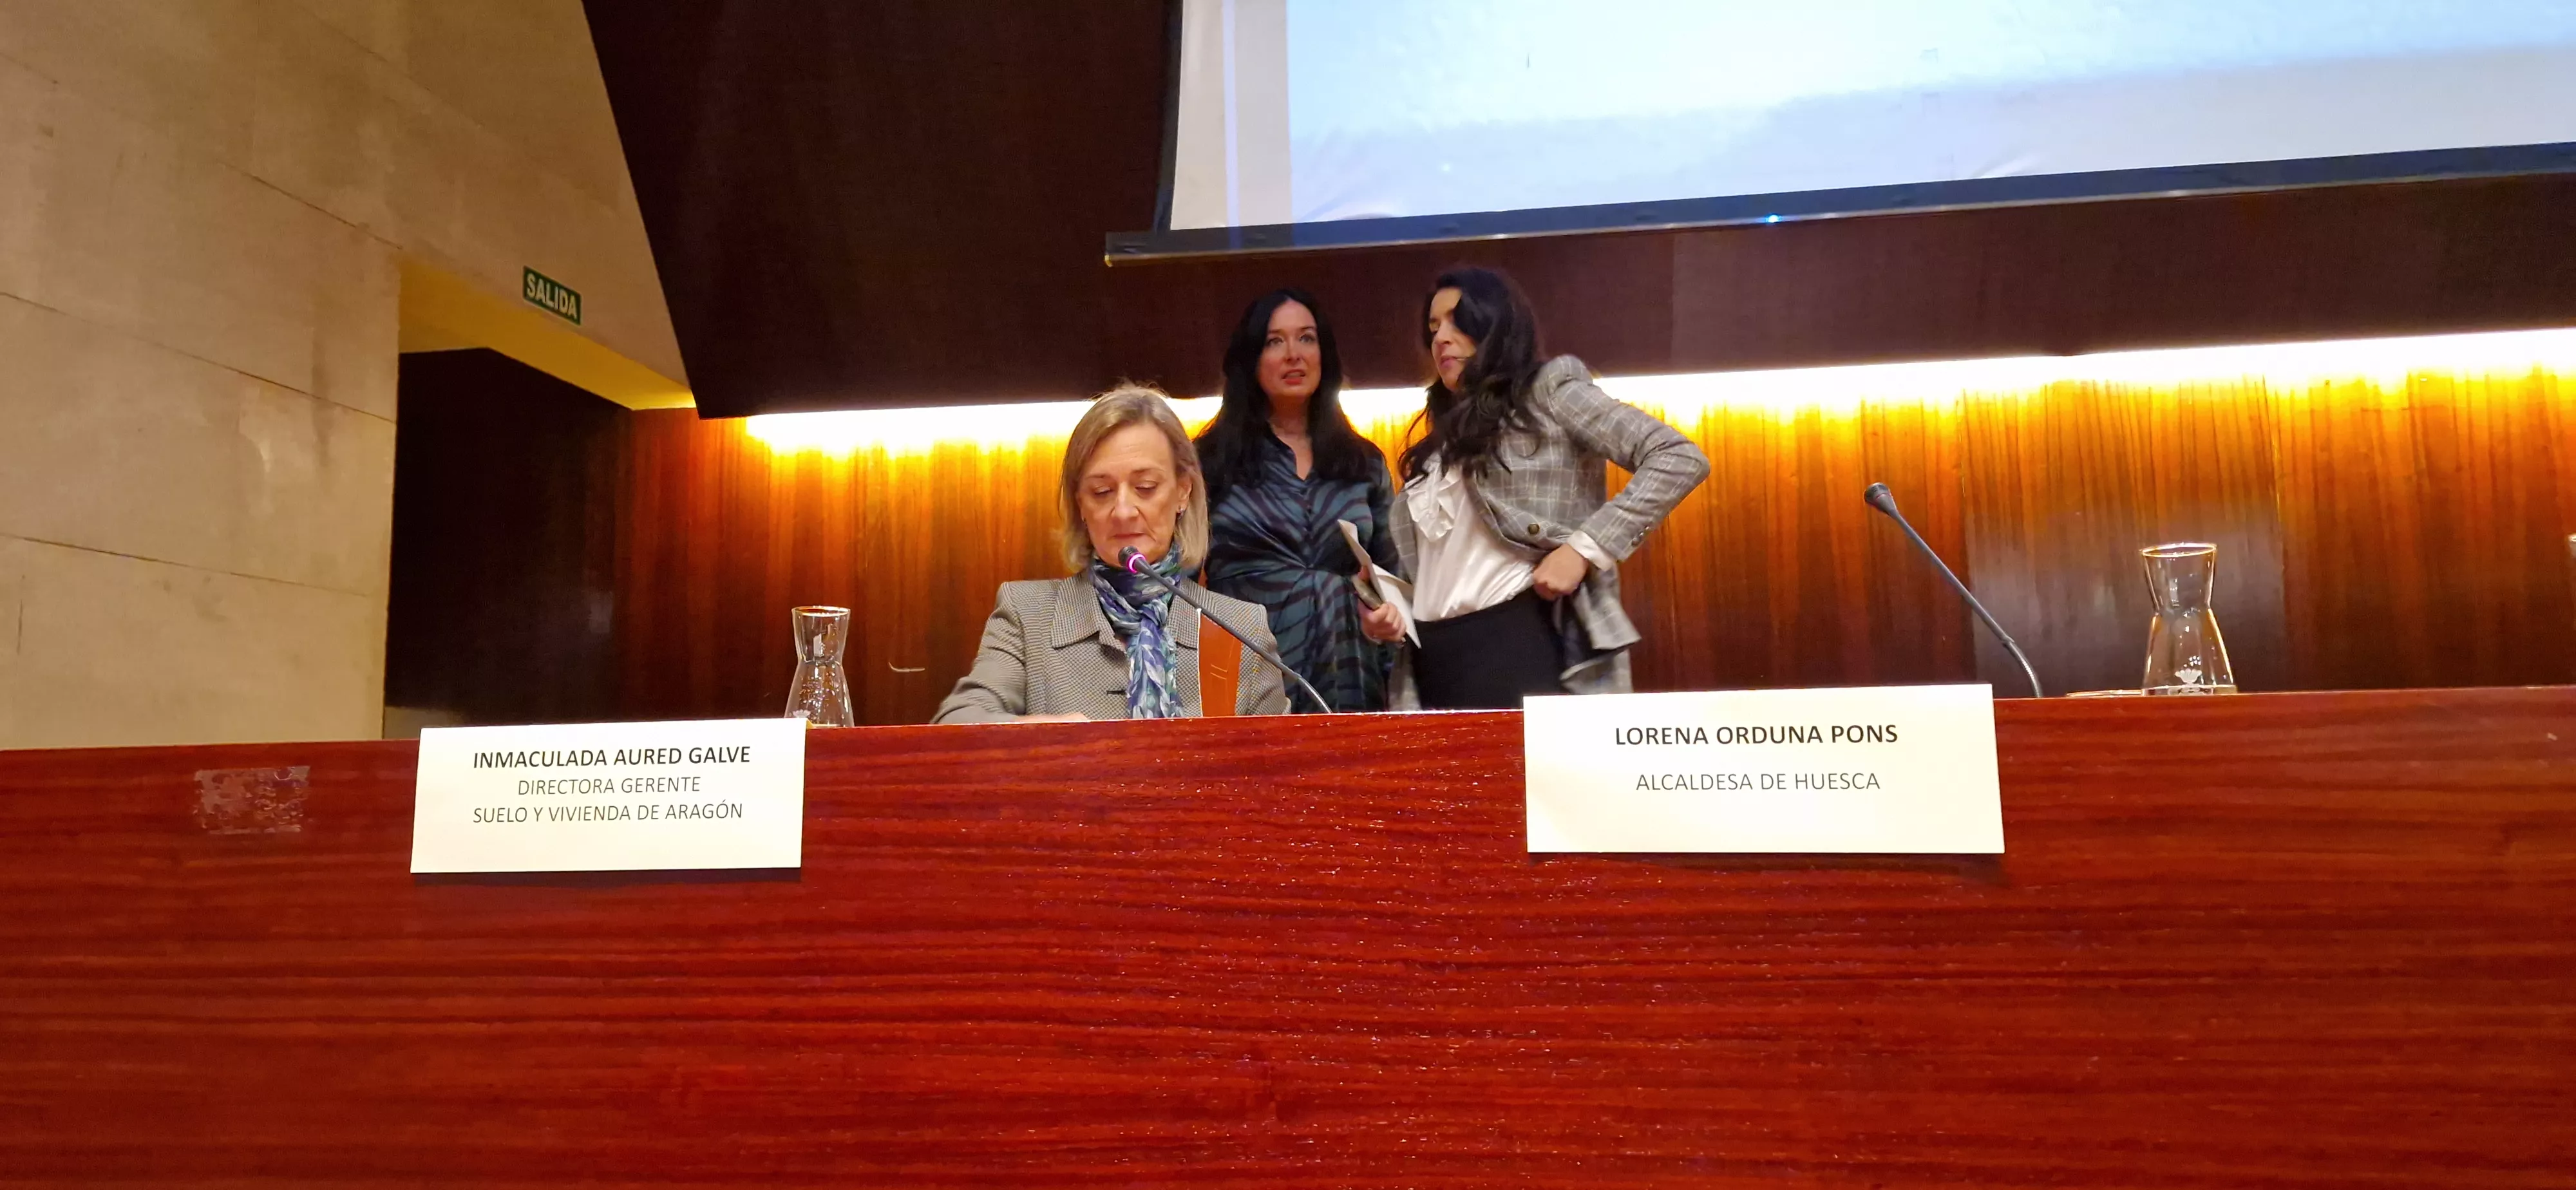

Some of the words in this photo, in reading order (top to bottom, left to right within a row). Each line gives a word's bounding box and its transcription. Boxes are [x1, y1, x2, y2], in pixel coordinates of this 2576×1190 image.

[527, 272, 578, 320] SALIDA
[1616, 726, 1709, 746] LORENA
[1716, 725, 1824, 745] ORDUNA
[1831, 724, 1898, 744] PONS
[473, 749, 607, 769] INMACULADA
[613, 748, 682, 766] AURED
[688, 746, 751, 764] GALVE
[518, 778, 615, 795] DIRECTORA
[621, 777, 701, 793] GERENTE
[1636, 773, 1753, 791] ALCALDESA
[1761, 773, 1787, 790] DE
[1795, 773, 1880, 790] HUESCA
[473, 807, 527, 824] SUELO
[533, 807, 544, 822] Y
[548, 805, 631, 822] VIVIENDA
[638, 804, 660, 820] DE
[665, 799, 743, 820] ARAGÓN
